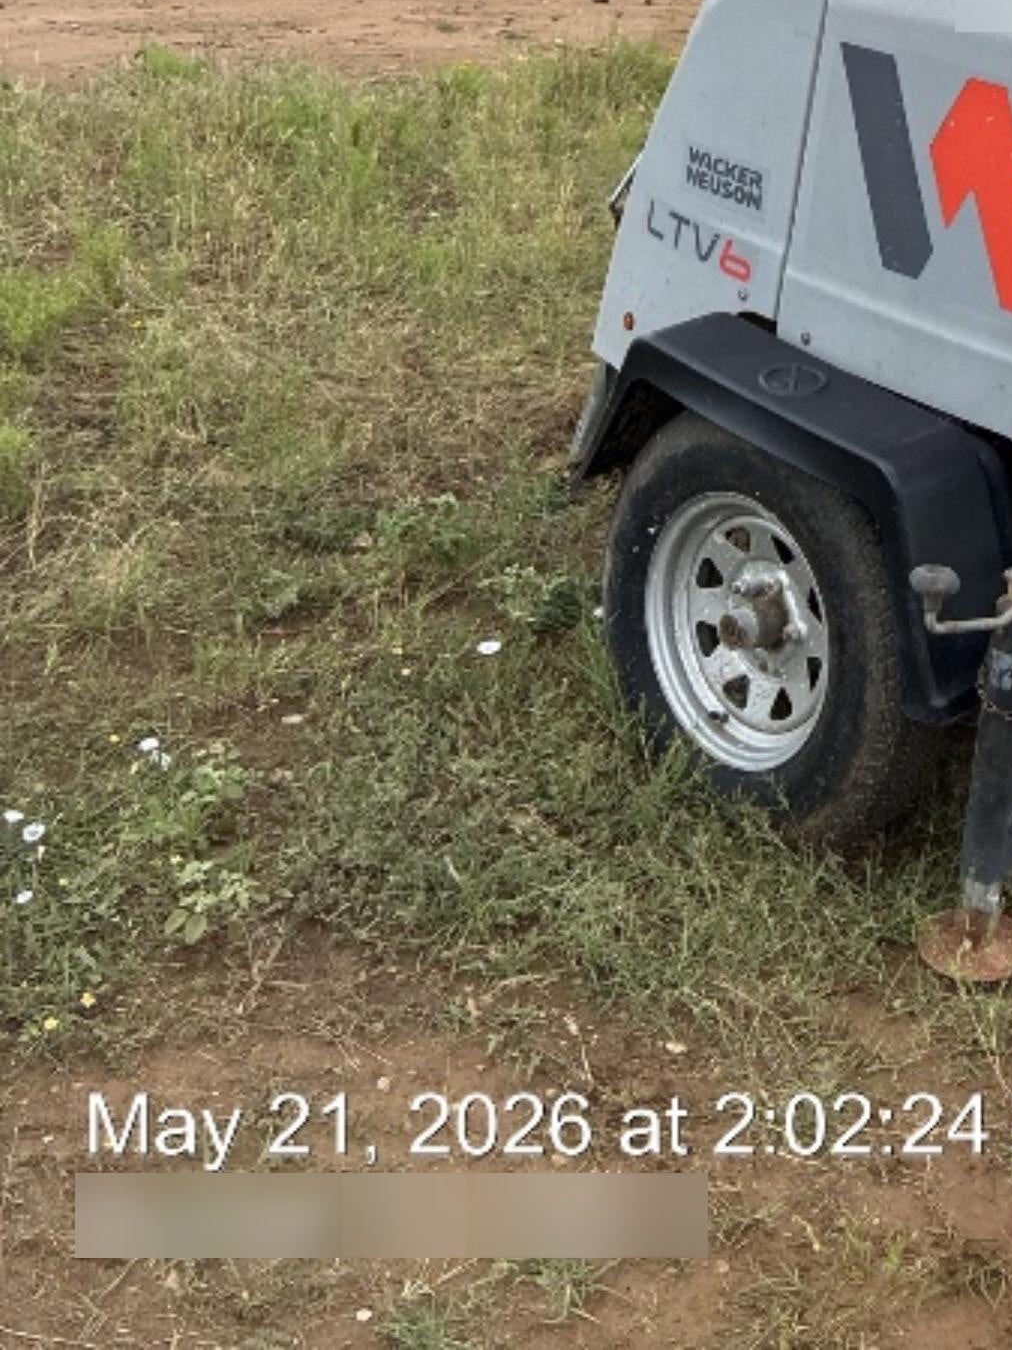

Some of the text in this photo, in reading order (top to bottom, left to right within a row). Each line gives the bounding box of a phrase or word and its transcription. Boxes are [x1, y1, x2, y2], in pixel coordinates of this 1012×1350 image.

[685, 164, 763, 211] NEUSON
[688, 146, 763, 188] WACKER
[647, 199, 752, 283] LTV6
